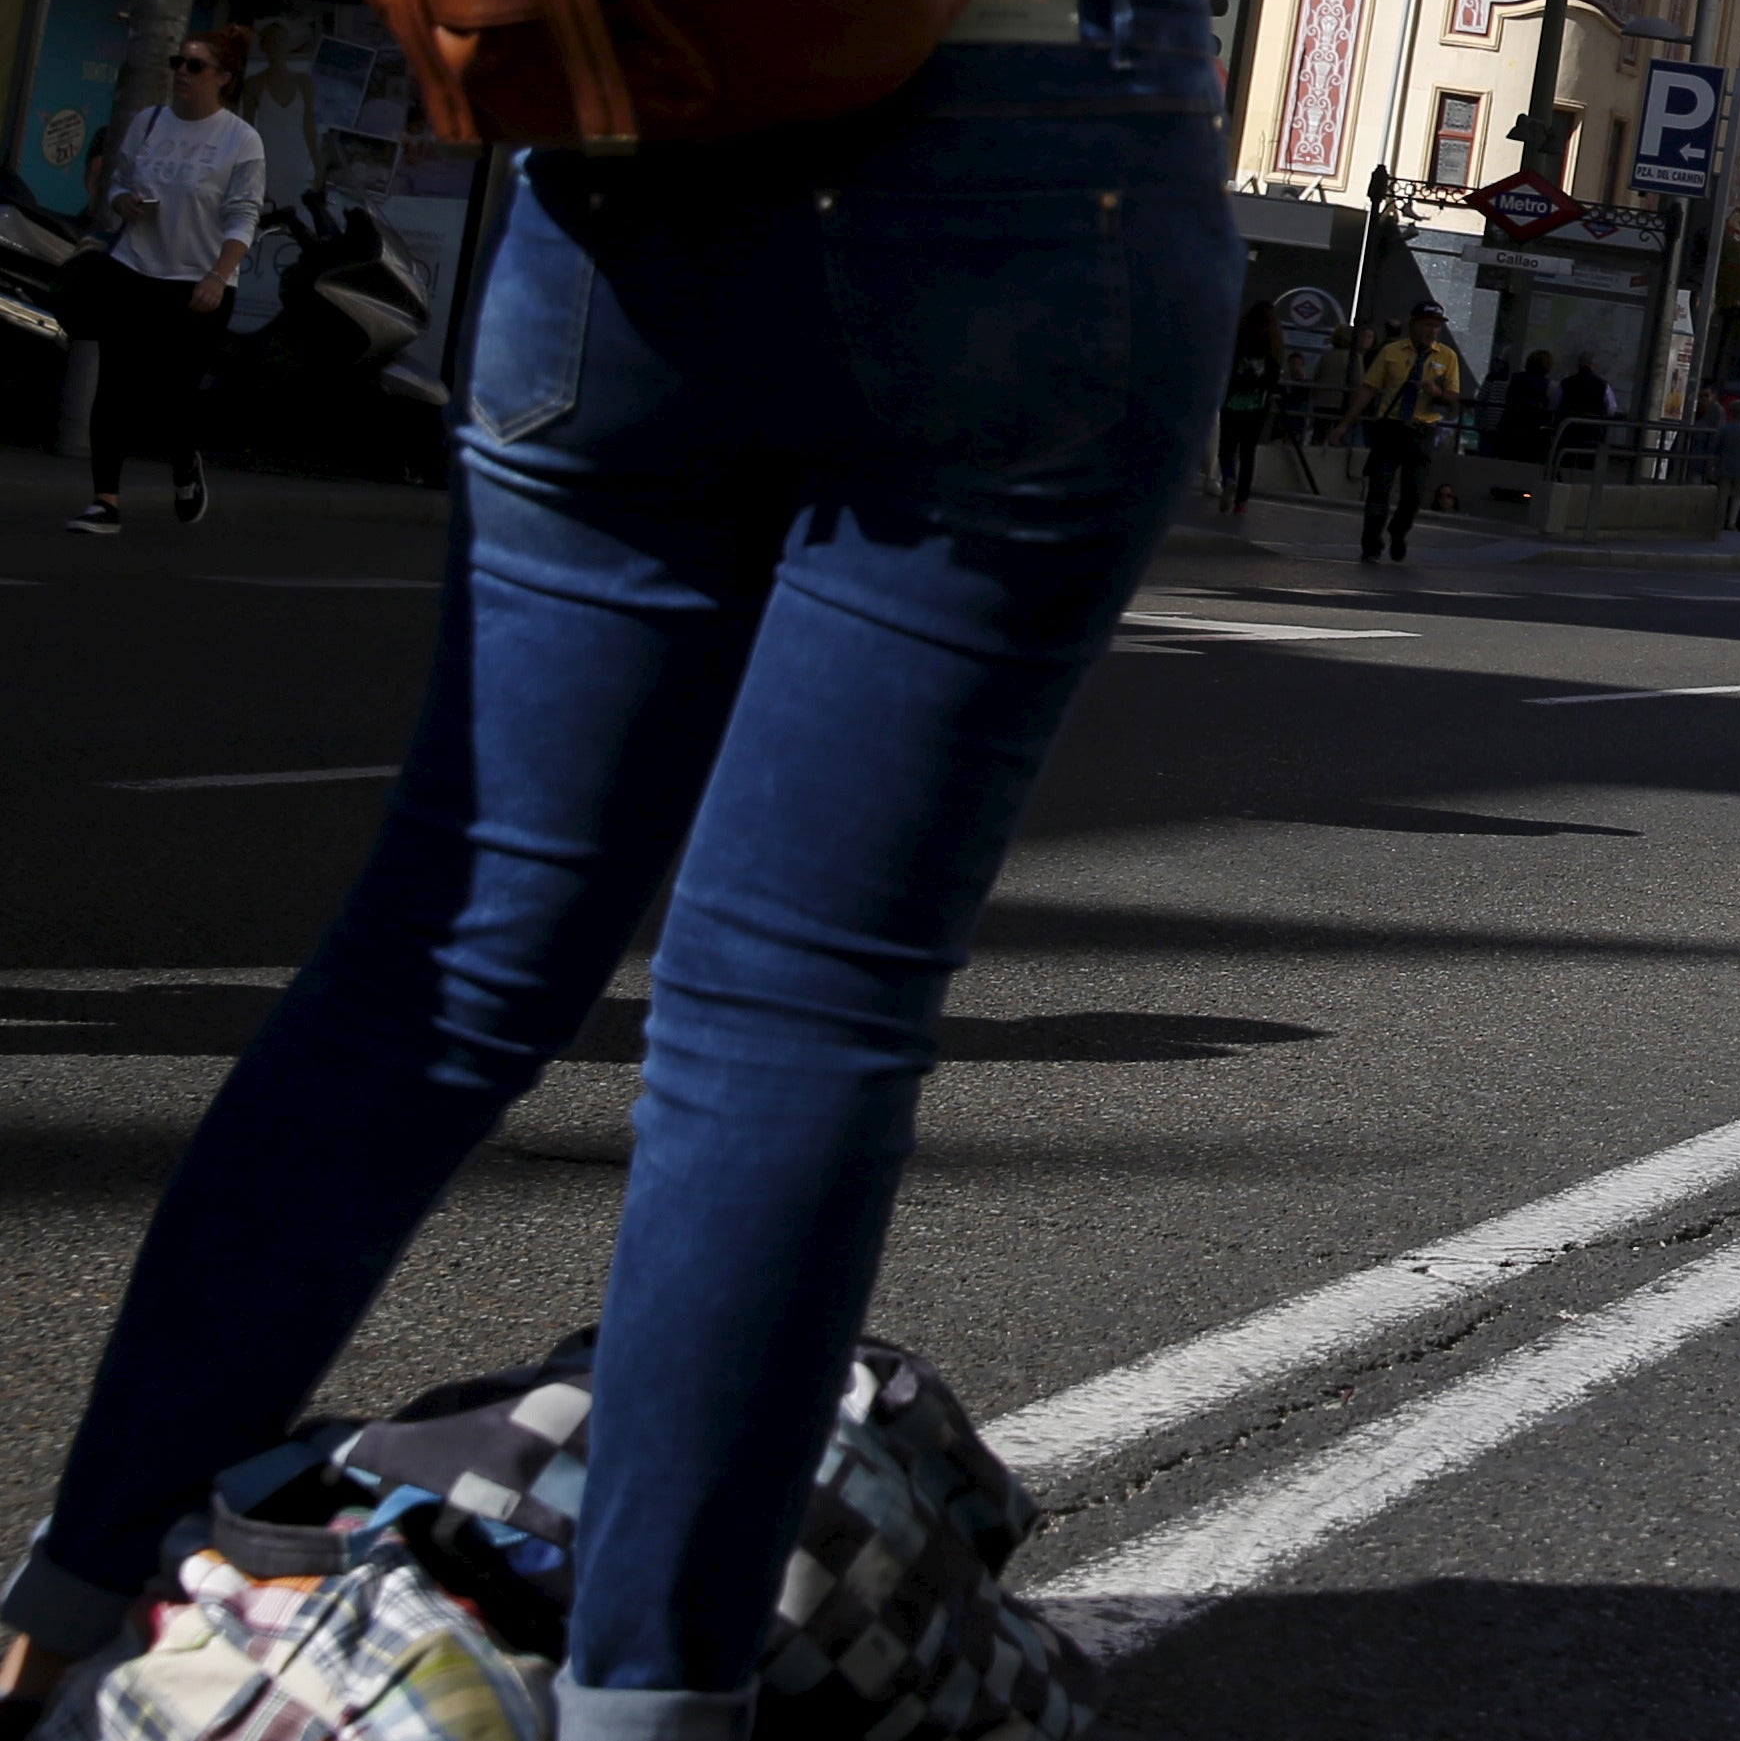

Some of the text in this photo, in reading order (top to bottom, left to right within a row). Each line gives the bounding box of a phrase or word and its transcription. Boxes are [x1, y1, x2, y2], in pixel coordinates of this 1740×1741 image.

[1640, 69, 1716, 157] P
[1637, 165, 1704, 186] PZA. DEL CARMEN
[1499, 193, 1548, 214] Metro
[1496, 251, 1539, 269] Callao
